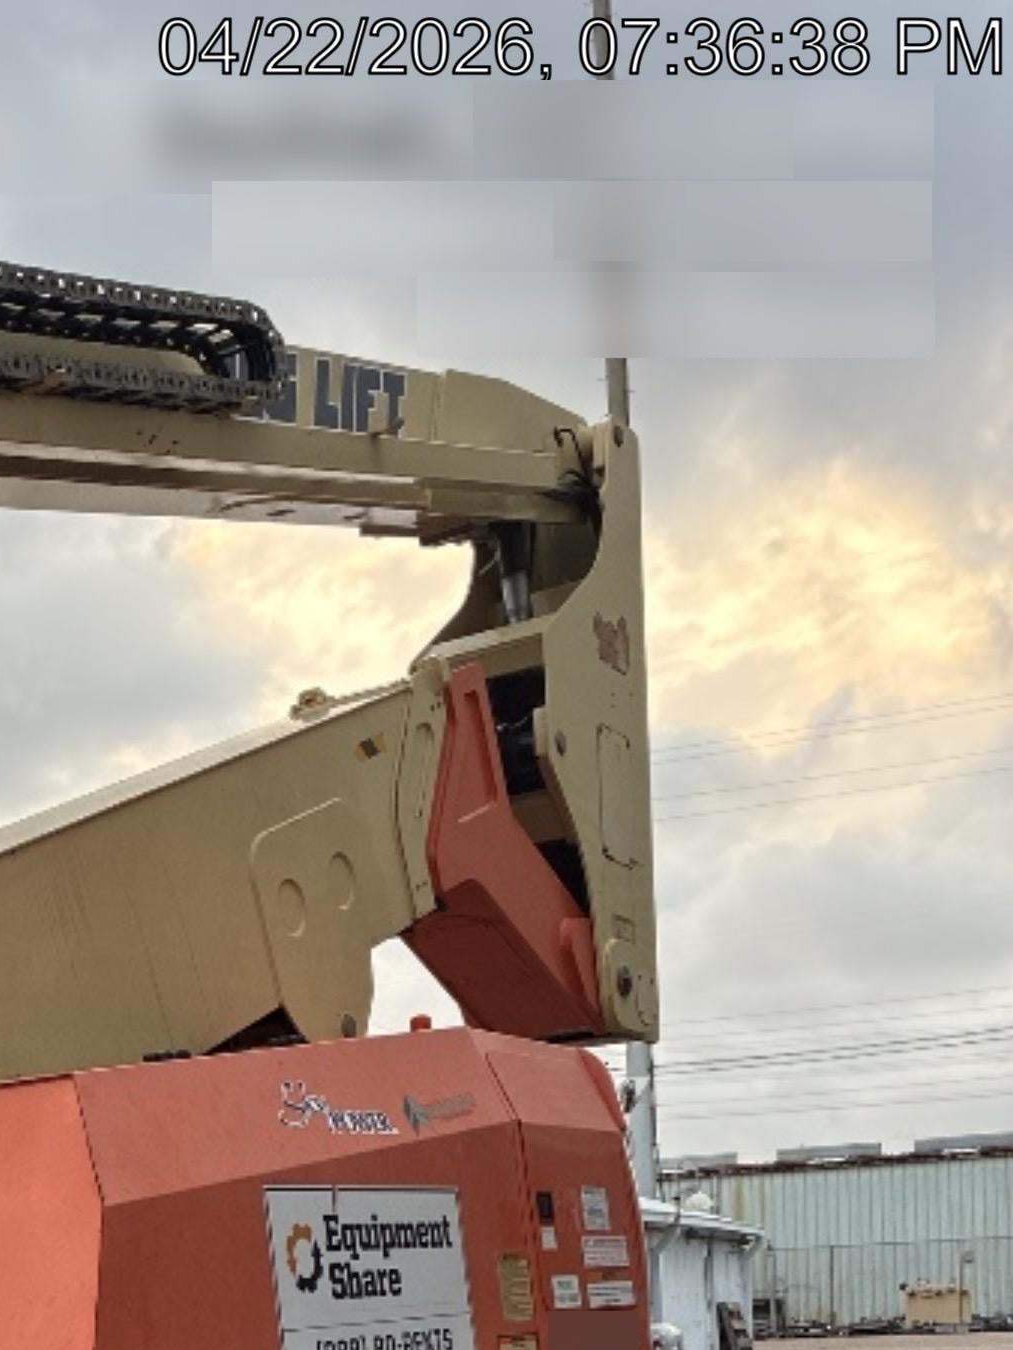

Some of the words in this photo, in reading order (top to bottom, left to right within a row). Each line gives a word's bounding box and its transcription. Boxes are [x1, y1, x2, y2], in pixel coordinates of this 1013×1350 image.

[312, 354, 408, 438] LIFT
[323, 1214, 453, 1260] Equipment
[329, 1262, 402, 1299] Share
